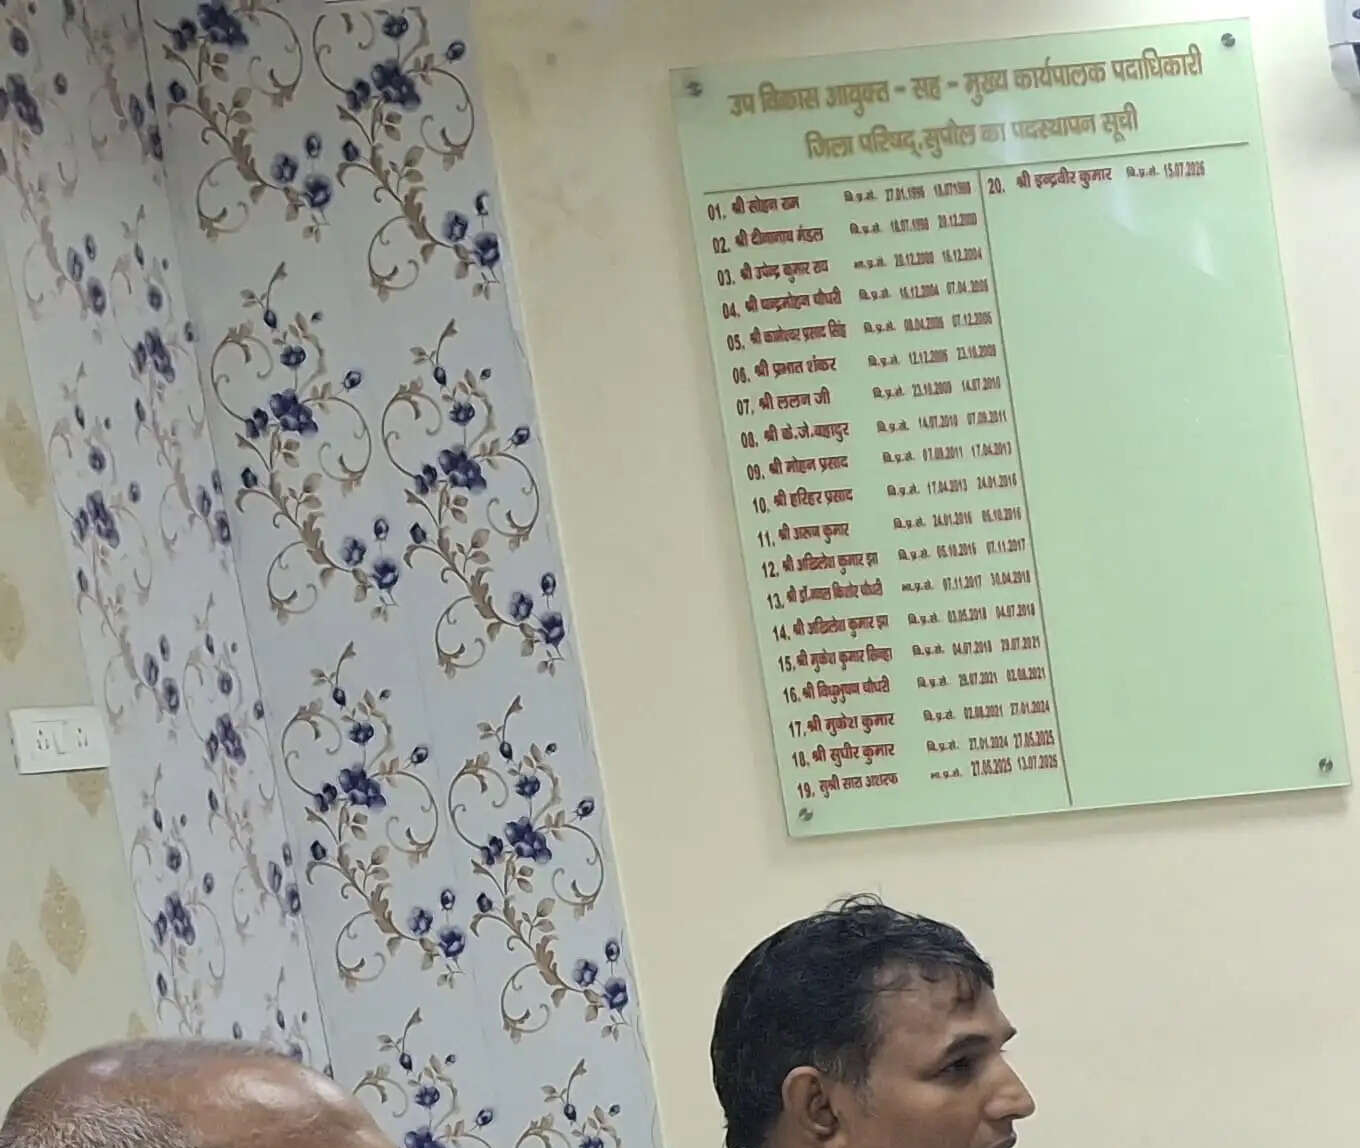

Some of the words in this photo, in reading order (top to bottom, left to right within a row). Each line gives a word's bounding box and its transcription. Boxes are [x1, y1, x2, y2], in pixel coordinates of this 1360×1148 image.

[727, 93, 756, 117] उप
[758, 81, 820, 113] विकास
[825, 80, 890, 117] आयुक्त
[909, 75, 941, 101] सह
[962, 69, 1009, 107] मुख्य
[1013, 56, 1107, 90] कार्यपालक
[1110, 43, 1203, 81] पदाधिकारी
[804, 130, 854, 159] जिला
[979, 123, 1006, 143] का
[1011, 113, 1097, 140] पदस्थापन
[1100, 101, 1139, 143] सूची
[987, 177, 1006, 195] 20.
[1016, 169, 1032, 189] श्री
[1077, 167, 1113, 190] कुमार
[707, 203, 727, 221] 01.
[731, 195, 746, 214] श्री
[712, 236, 731, 254] 02.
[734, 228, 748, 247] श्री
[717, 268, 736, 287] 03.
[739, 261, 753, 281] श्री
[782, 261, 811, 284] कुमार
[722, 302, 741, 320] 04.
[744, 294, 758, 313] श्री
[726, 333, 745, 352] 05.
[749, 326, 762, 345] श्री
[732, 366, 751, 385] 06.
[754, 358, 770, 377] श्री
[806, 354, 837, 373] शंकर
[736, 398, 754, 416] 07.
[758, 391, 775, 410] श्री
[776, 393, 811, 410] ललन
[813, 386, 831, 405] जी
[740, 431, 759, 449] 08.
[763, 423, 779, 442] श्री
[746, 463, 765, 481] 09.
[768, 456, 783, 475] श्री
[752, 496, 770, 514] 10.
[773, 488, 787, 507] श्री
[757, 531, 776, 548] 11.
[778, 522, 791, 541] श्री
[822, 522, 850, 545] कुमार
[761, 561, 780, 578] 12.
[782, 554, 795, 572] श्री
[837, 553, 865, 576] कुमार
[766, 592, 785, 610] 13.
[786, 584, 797, 603] श्री
[772, 624, 791, 641] 14.
[792, 617, 806, 636] श्री
[847, 615, 875, 638] कुमार
[778, 655, 796, 673] 15.
[796, 648, 809, 666] श्री
[838, 649, 865, 671] कुमार
[783, 686, 801, 704] 16.
[802, 681, 816, 699] श्री
[788, 720, 807, 738] 17.
[806, 713, 822, 732] श्री
[824, 712, 859, 737] मुकेश
[861, 712, 895, 735] कुमार
[791, 750, 810, 768] 18.
[812, 744, 827, 762] श्री
[829, 741, 860, 768] सुधीर
[862, 743, 895, 766] कुमार
[797, 782, 815, 799] 19.
